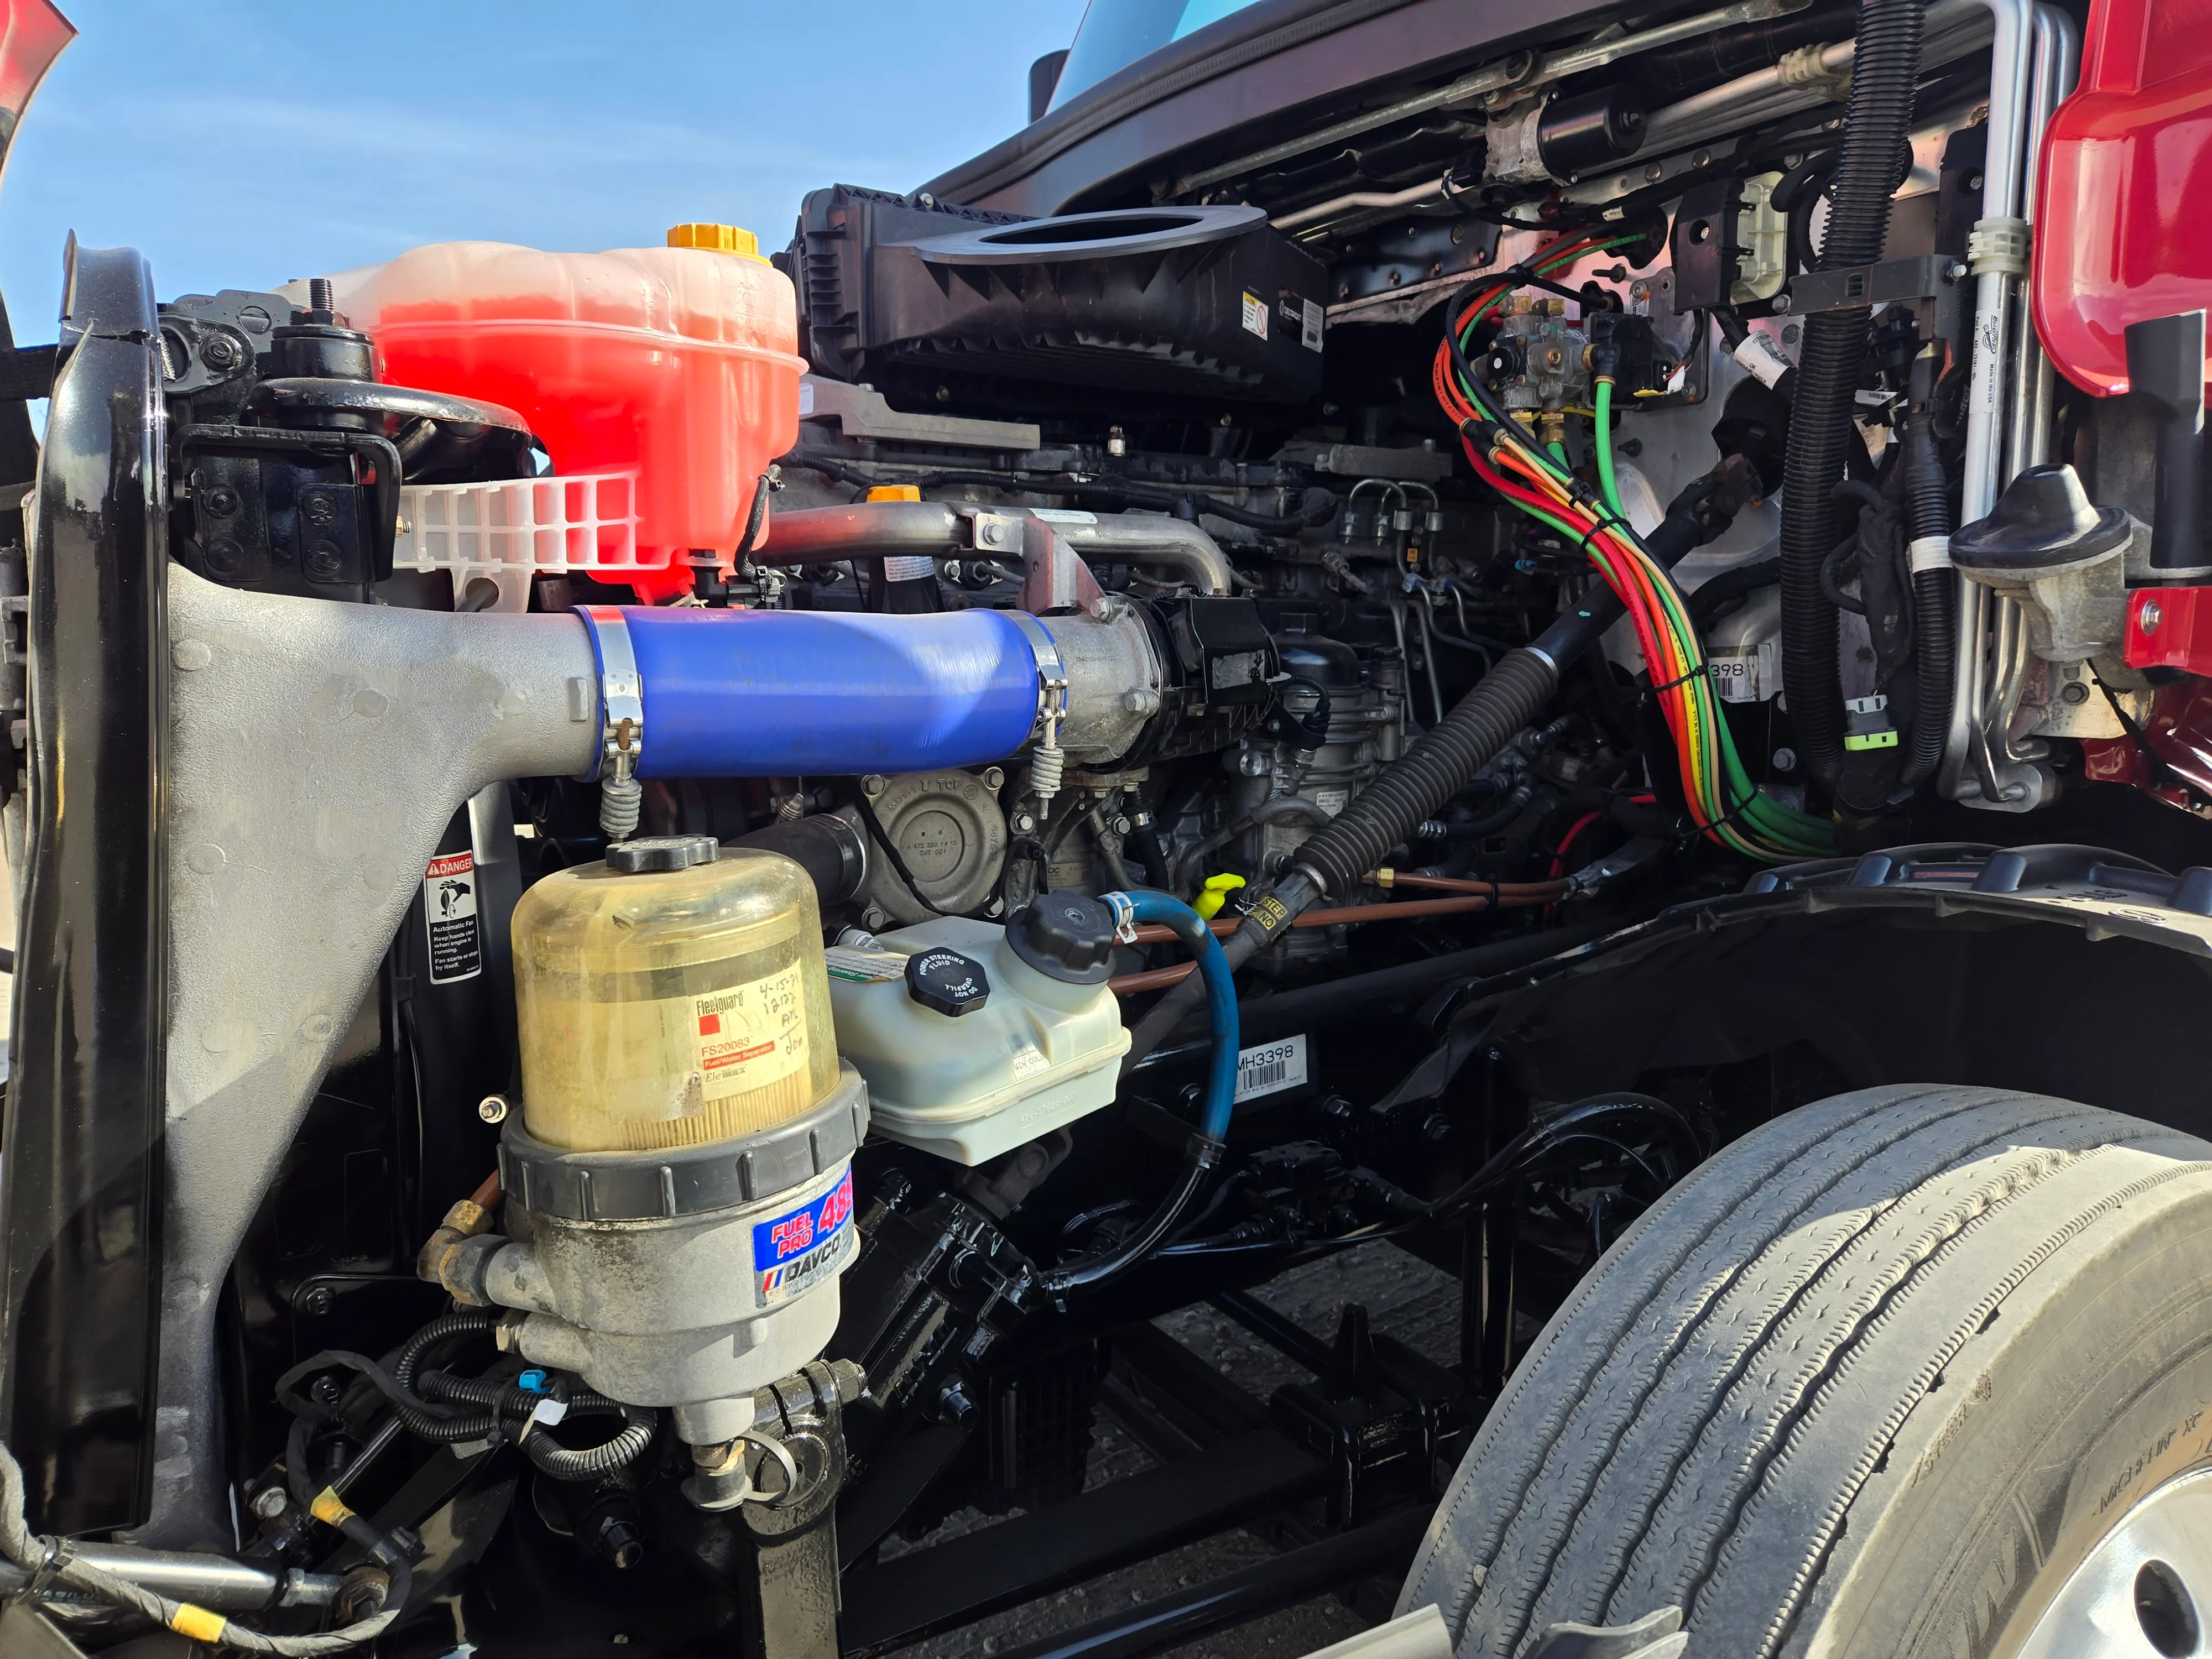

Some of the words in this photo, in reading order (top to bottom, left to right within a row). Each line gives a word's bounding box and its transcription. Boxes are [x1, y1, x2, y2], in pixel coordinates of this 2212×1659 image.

[936, 779, 963, 791] TOP
[439, 857, 473, 874] DANGER
[1263, 897, 1285, 916] STEP
[433, 922, 465, 933] Automatic
[465, 920, 474, 929] Fan
[434, 935, 450, 943] Keep
[449, 932, 466, 940] hands
[450, 938, 467, 947] engine
[434, 947, 458, 956] running.
[446, 954, 463, 963] starts
[919, 958, 931, 976] POWER
[928, 954, 965, 965] STEERING
[929, 960, 950, 970] FLUID
[945, 977, 973, 992] OVERFILL
[968, 986, 978, 994] DO
[696, 990, 744, 1016] Fleetguard
[702, 1036, 750, 1057] FS20083
[705, 1050, 742, 1067] Fuel/Water
[742, 1044, 772, 1059] Separator
[771, 1211, 815, 1243] FUEL
[778, 1228, 812, 1259] PRO
[785, 1233, 840, 1282] DAVCO
